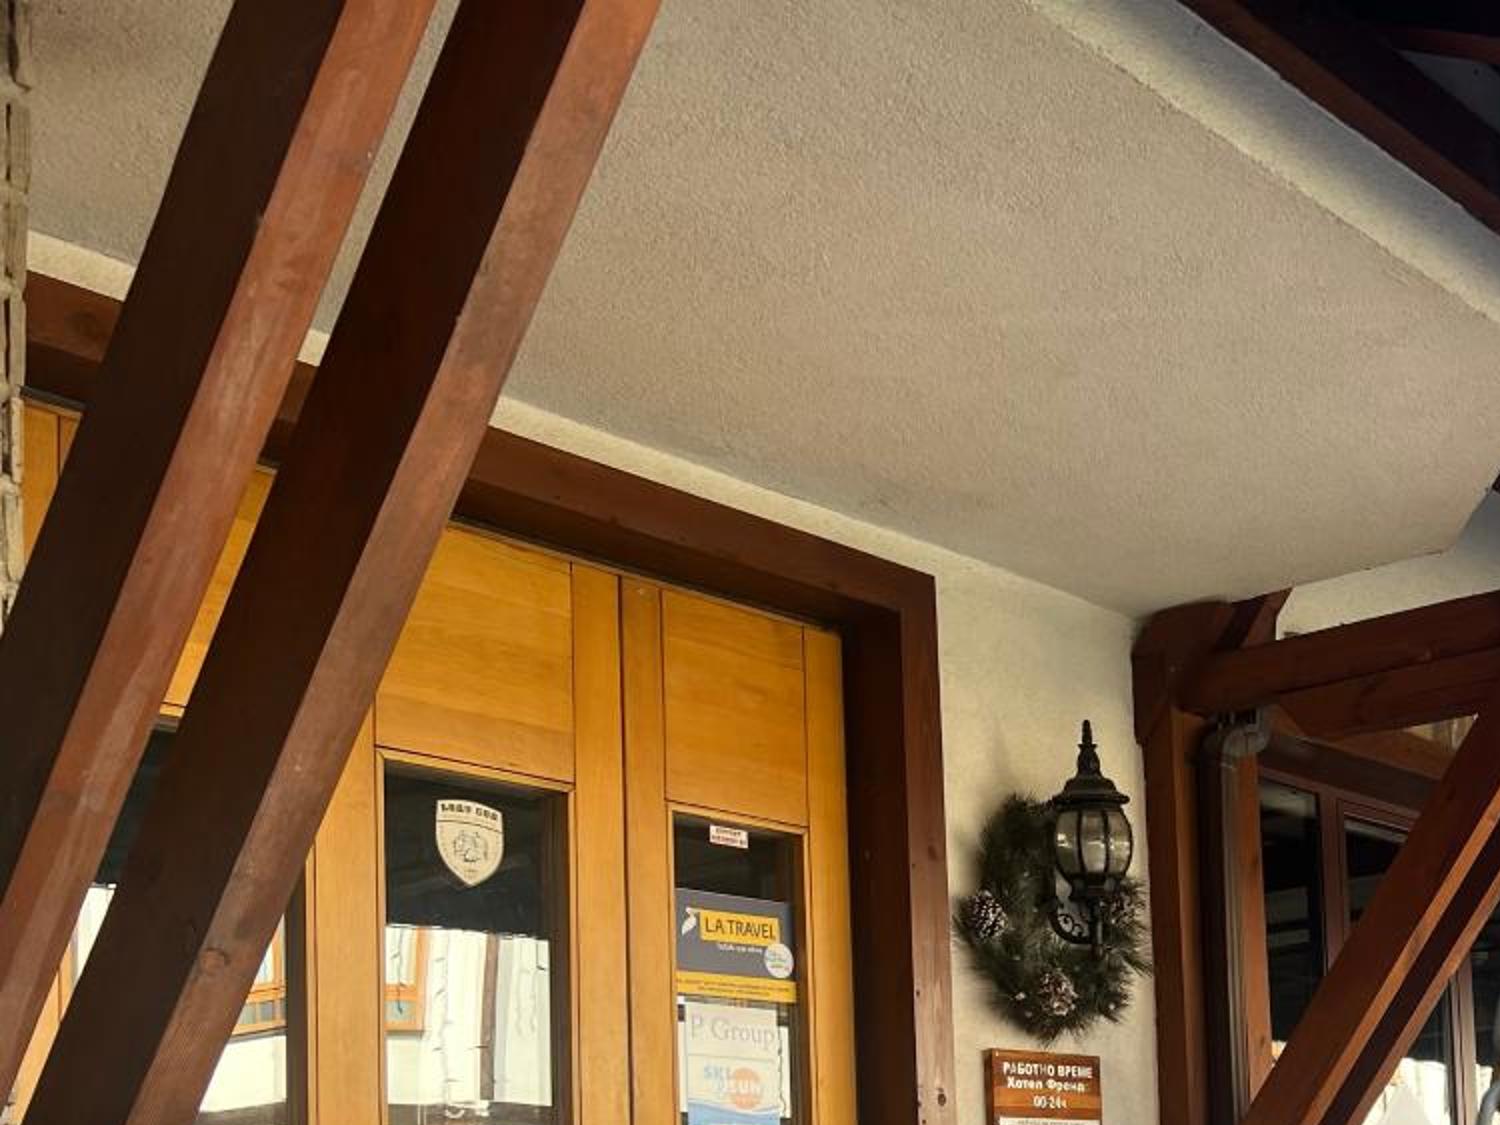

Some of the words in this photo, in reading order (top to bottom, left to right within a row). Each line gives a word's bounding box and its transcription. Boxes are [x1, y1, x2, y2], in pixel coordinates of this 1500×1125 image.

[705, 917, 725, 934] LA
[727, 920, 776, 940] TRAVEL
[712, 1017, 775, 1051] Group
[1002, 1061, 1055, 1077] РАБОТНО
[1058, 1065, 1093, 1079] ВРЕМЕ
[1007, 1076, 1043, 1090] Хотел
